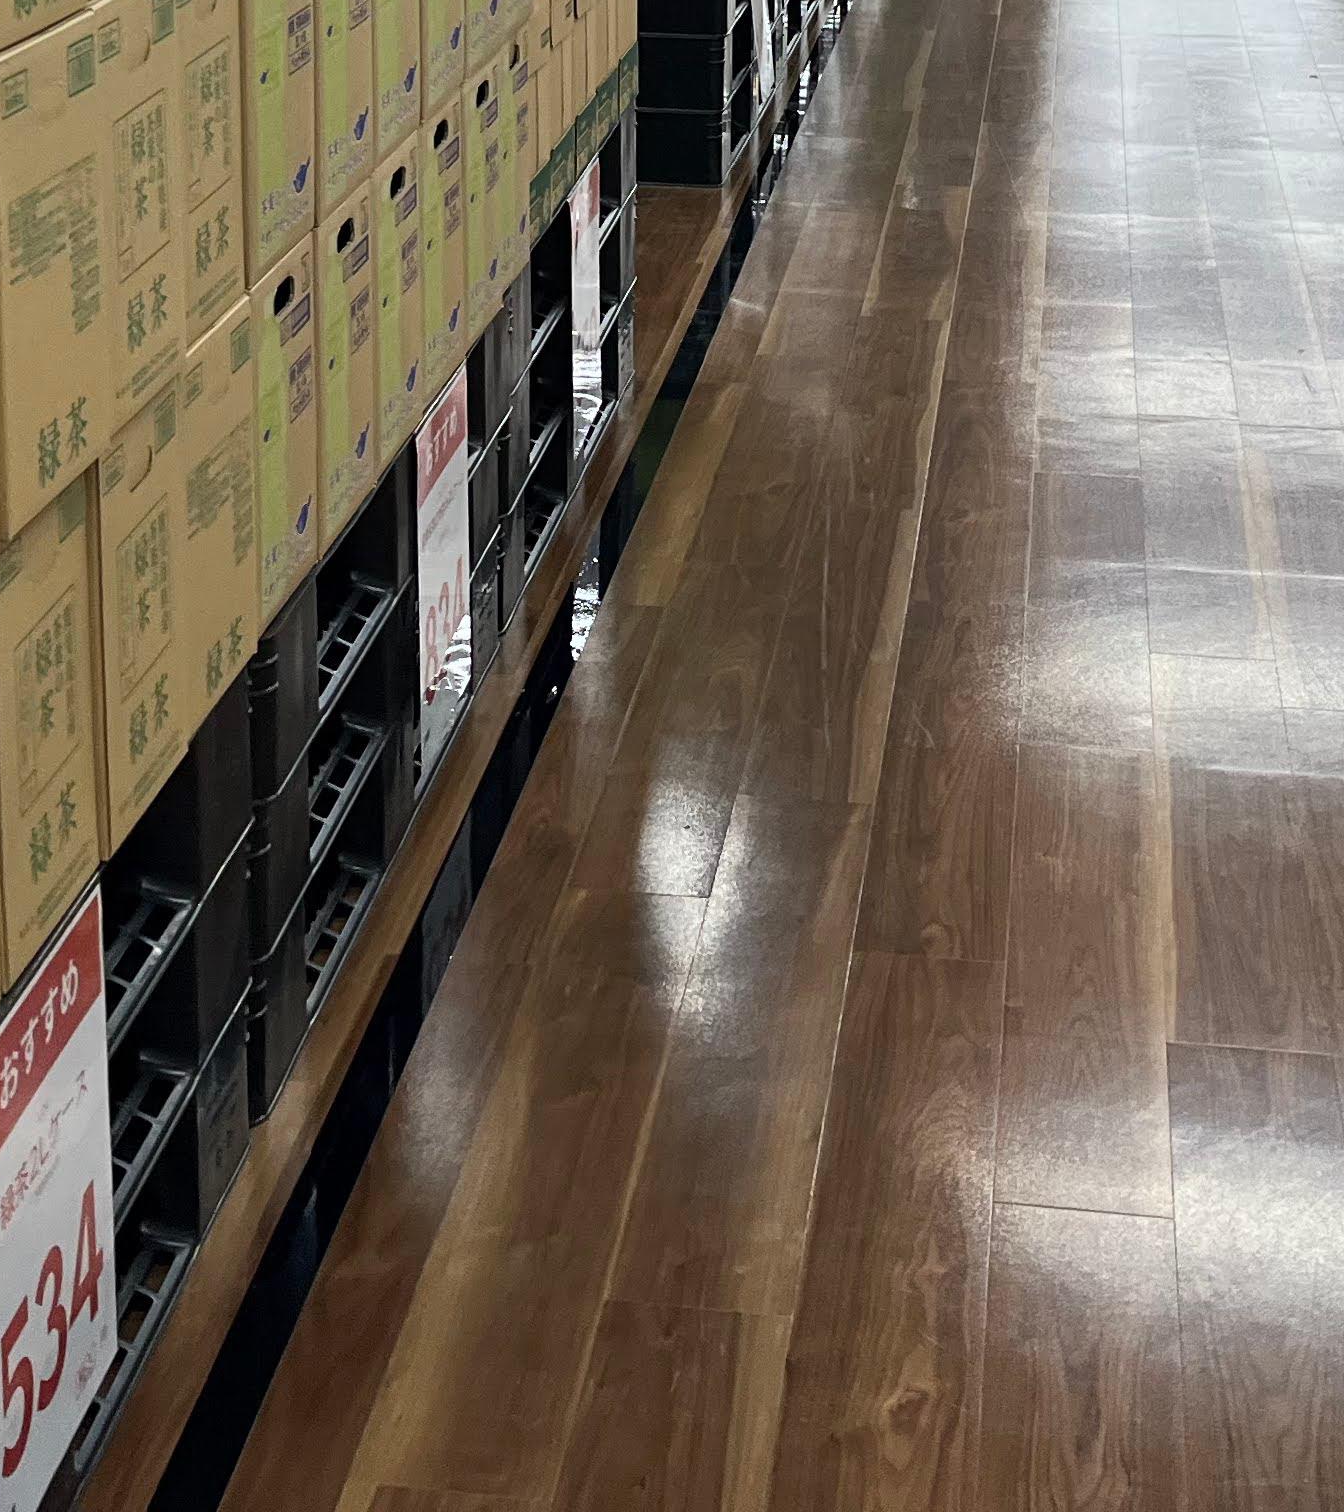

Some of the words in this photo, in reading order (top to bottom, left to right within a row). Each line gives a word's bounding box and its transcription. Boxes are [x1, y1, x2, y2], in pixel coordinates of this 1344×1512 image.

[0, 958, 80, 1110] おすすめ
[0, 1178, 104, 1478] 534
